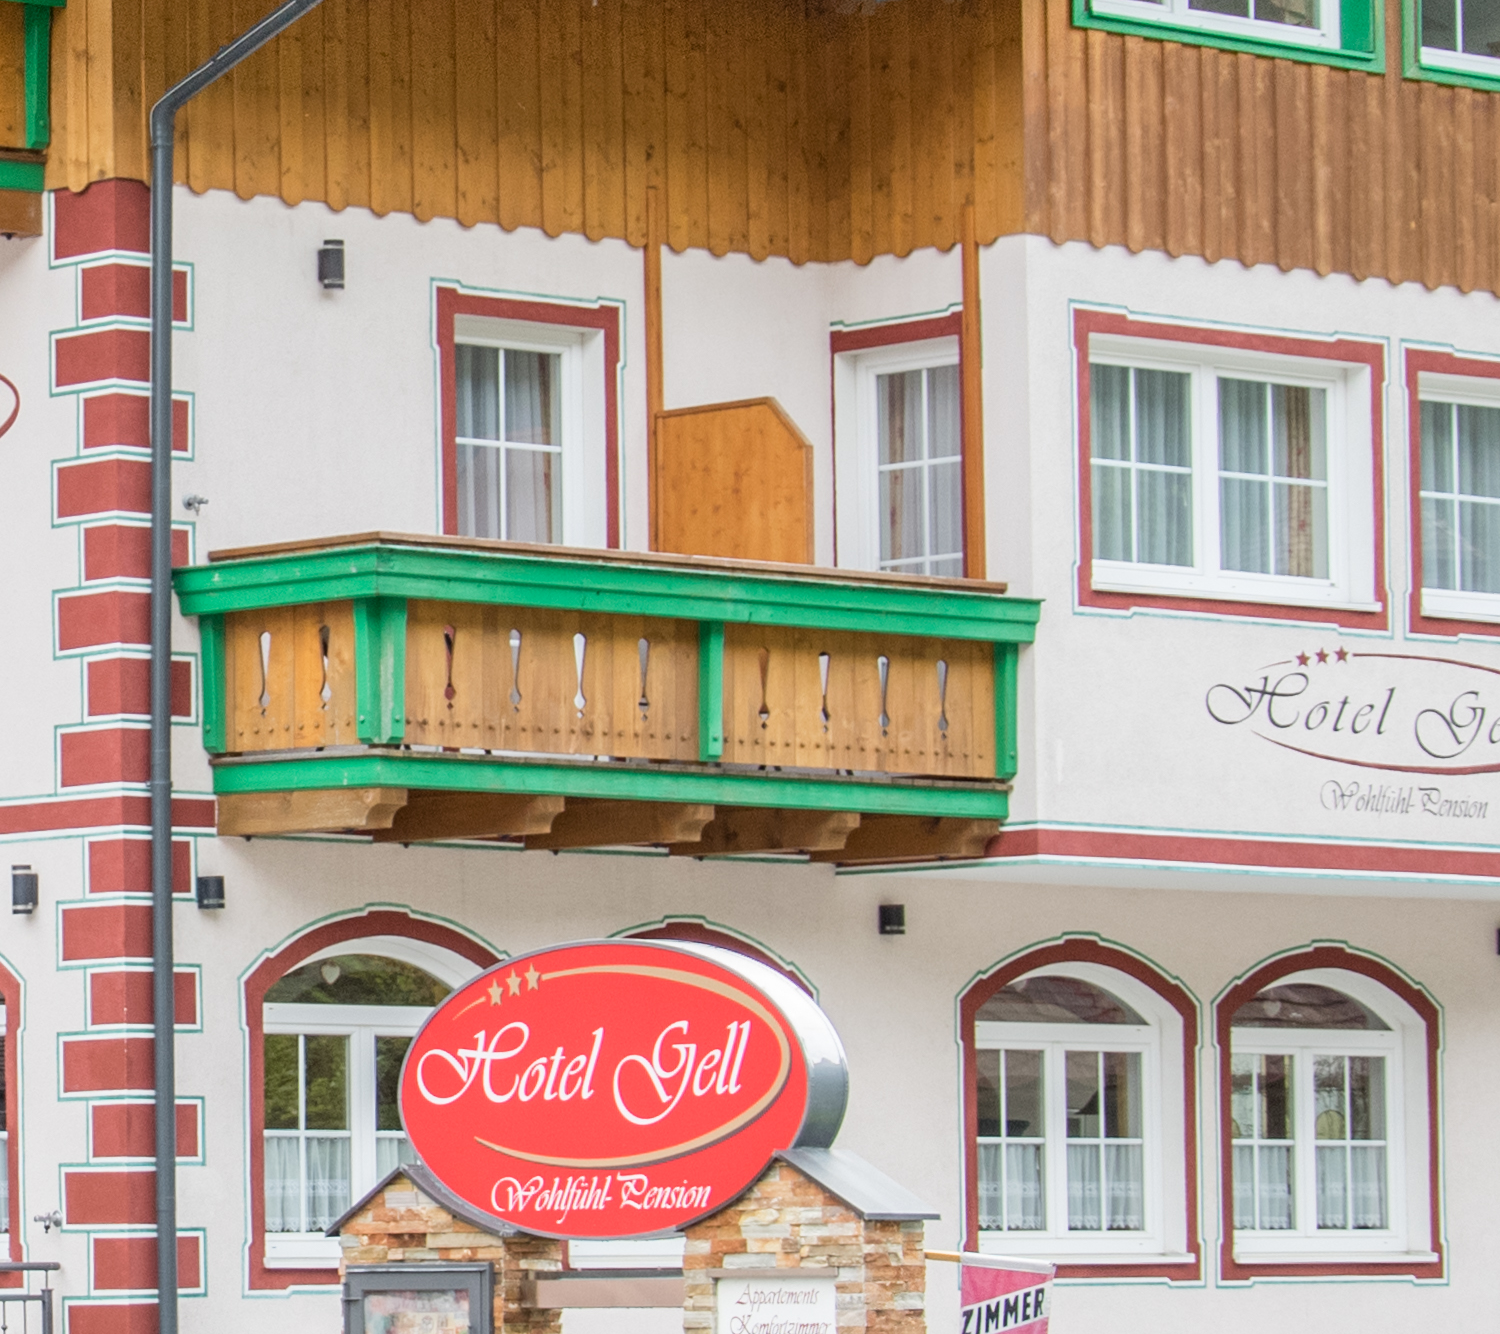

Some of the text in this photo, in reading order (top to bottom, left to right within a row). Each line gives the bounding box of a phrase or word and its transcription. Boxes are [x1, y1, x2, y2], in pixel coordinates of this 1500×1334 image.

[1204, 671, 1397, 735] Hotel
[415, 1019, 752, 1127] Hotel Gell
[735, 1282, 820, 1312] Appartements
